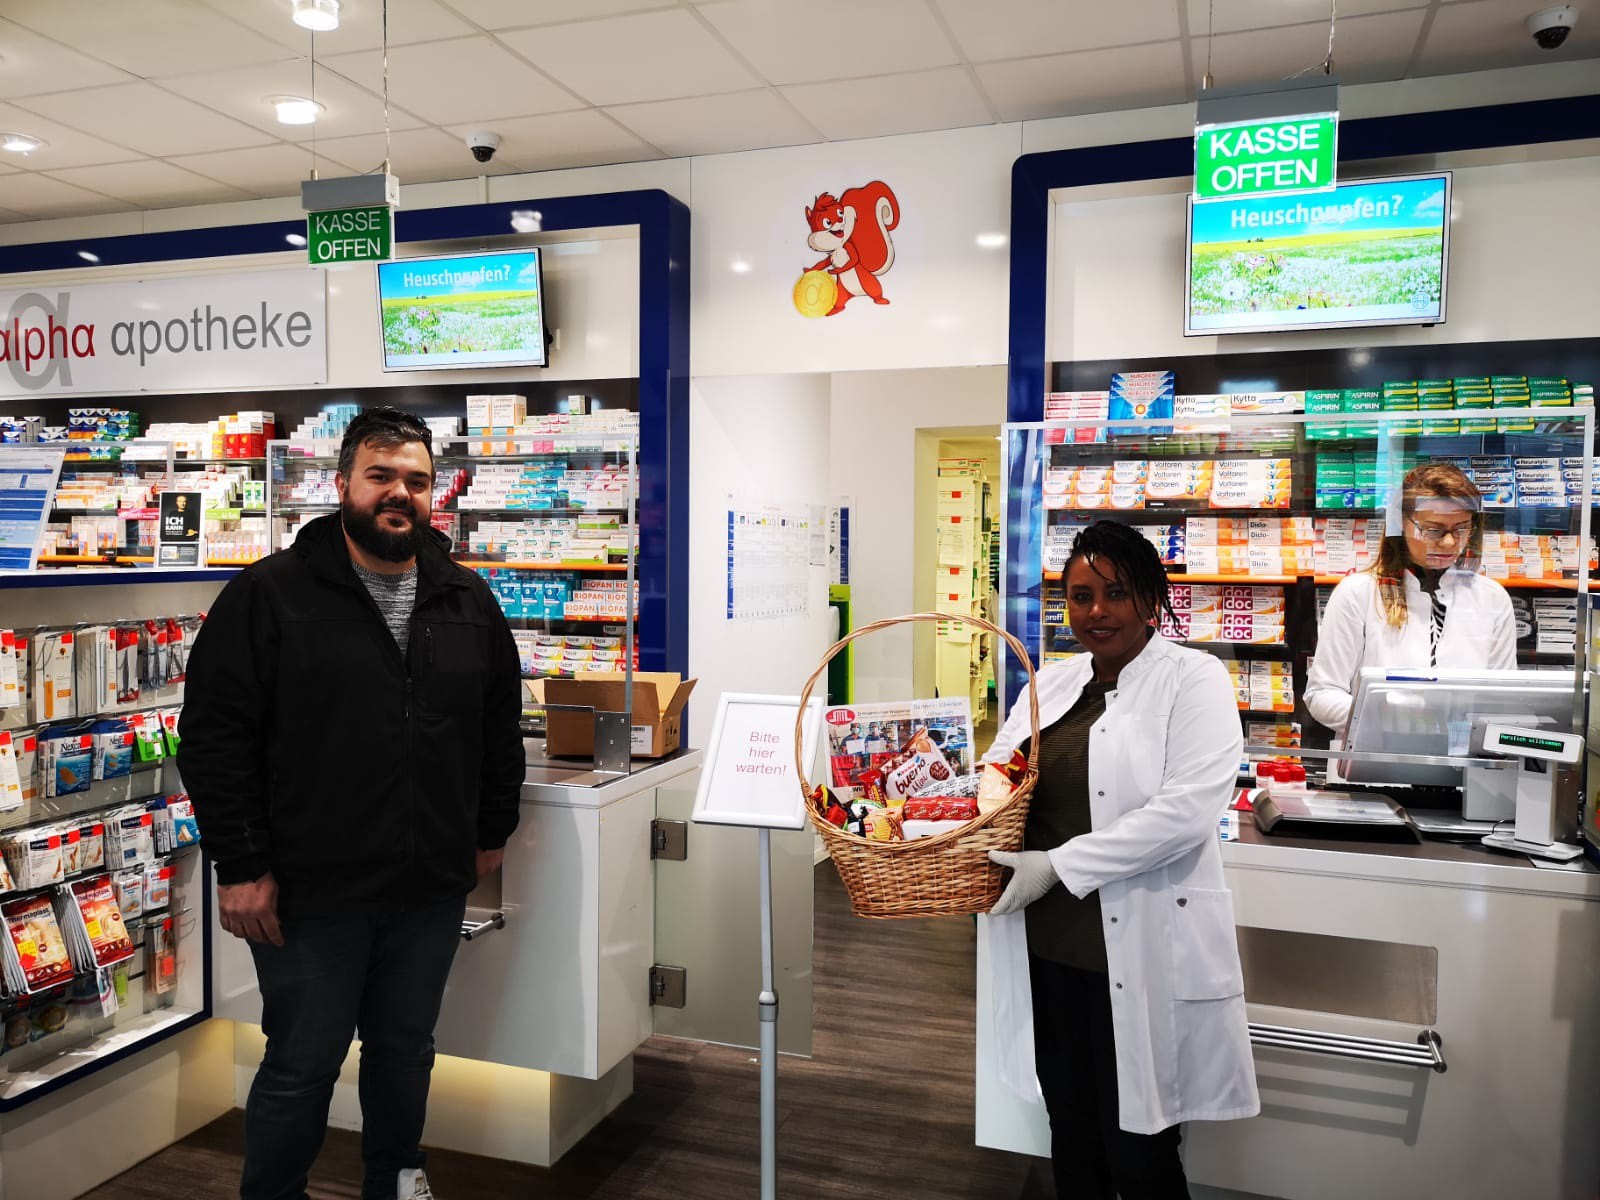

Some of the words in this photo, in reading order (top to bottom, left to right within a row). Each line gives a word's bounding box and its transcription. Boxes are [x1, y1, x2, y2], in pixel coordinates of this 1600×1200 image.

[1209, 123, 1321, 159] KASSE
[1211, 158, 1318, 192] OFFEN
[1231, 195, 1404, 230] Heuschnupfen?
[316, 211, 382, 235] KASSE
[317, 237, 382, 261] OFFEN
[403, 264, 512, 289] Heuschnupfen?
[111, 301, 313, 367] apotheke
[1176, 396, 1196, 404] Kytta
[1233, 395, 1256, 403] Kytta
[165, 517, 184, 525] ICH
[583, 581, 612, 589] RIOPAN
[1225, 586, 1252, 597] doc
[574, 592, 604, 600] RIOPAN
[565, 604, 595, 612] RIOPAN
[1225, 597, 1252, 609] doc
[1224, 614, 1252, 625] doc
[1162, 623, 1190, 637] doc
[1224, 625, 1252, 638] doc
[750, 731, 780, 744] Bitte
[60, 743, 81, 753] Nexca
[749, 747, 776, 759] hier
[736, 763, 787, 776] warten!
[895, 759, 926, 795] bueno
